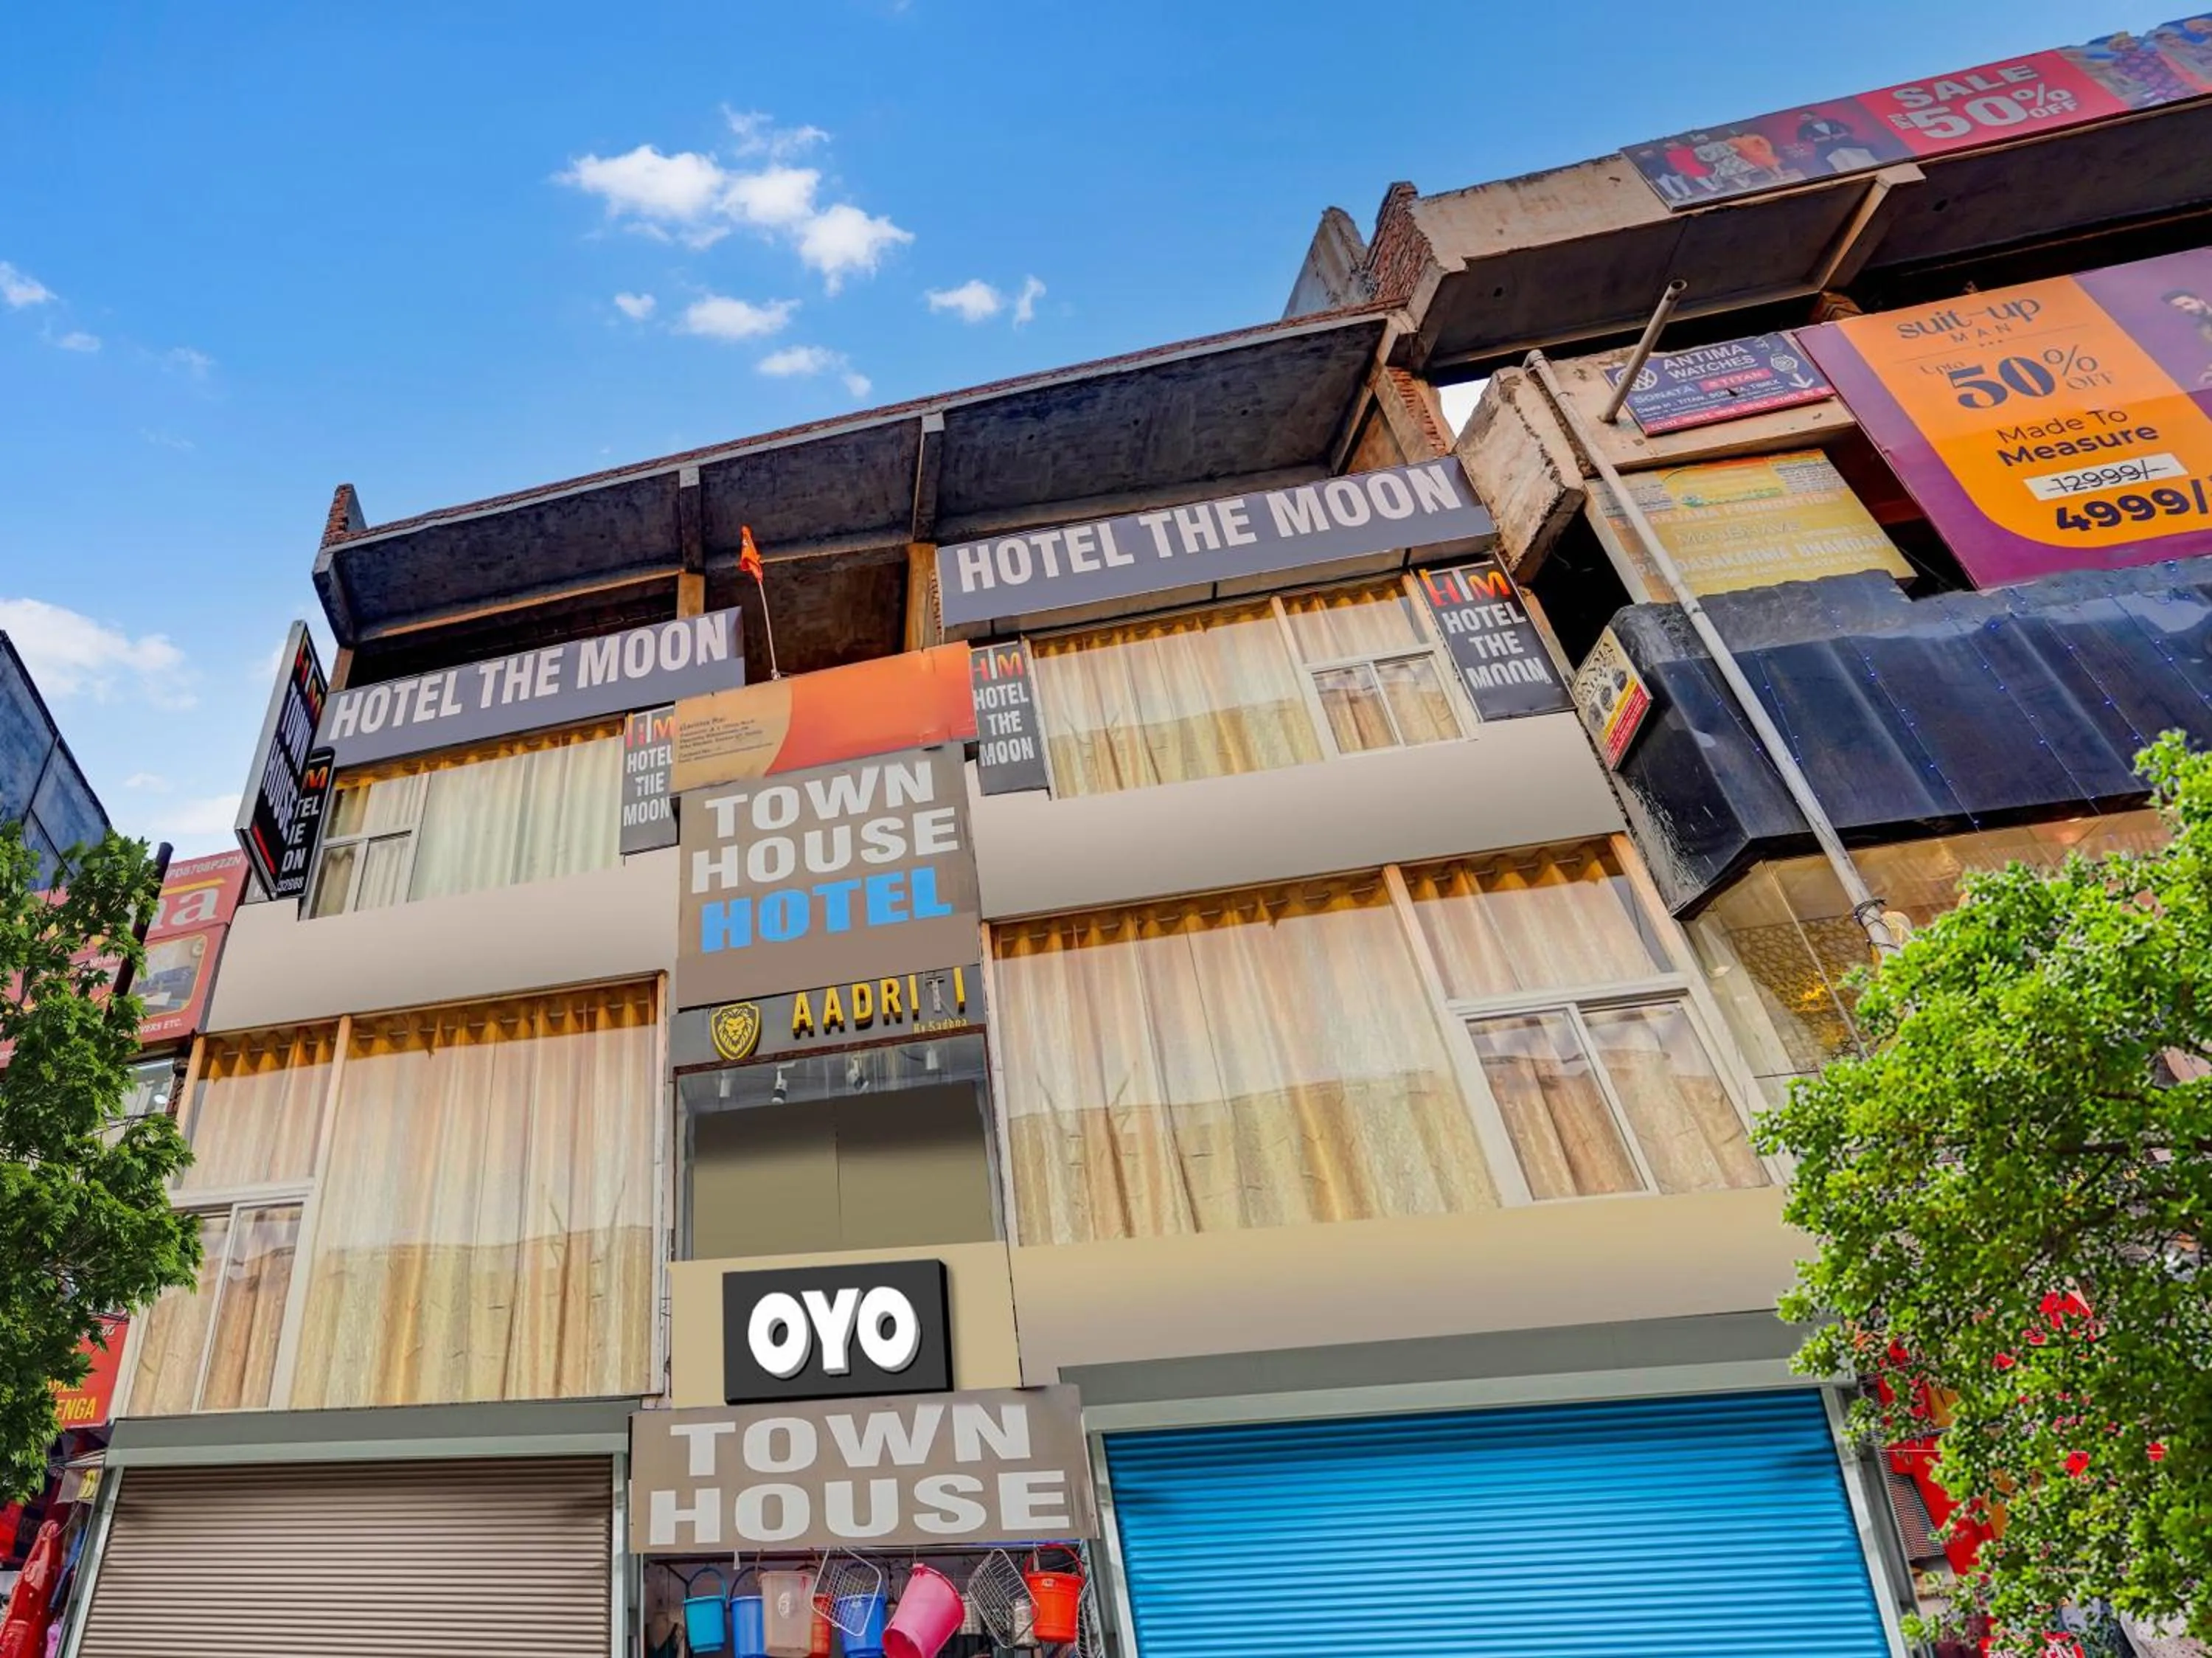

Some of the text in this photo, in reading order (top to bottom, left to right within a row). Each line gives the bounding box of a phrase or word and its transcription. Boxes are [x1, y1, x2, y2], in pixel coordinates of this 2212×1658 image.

[1892, 64, 2039, 108] SALE
[1907, 83, 2073, 139] 50%
[2029, 102, 2078, 118] OFF
[1896, 298, 2041, 339] suit-up
[1950, 322, 2011, 343] MAN
[1663, 344, 1750, 370] ANTIMA
[1667, 355, 1756, 380] WATCHES
[1718, 371, 1763, 388] TITAN
[1948, 344, 2099, 409] 50%
[2065, 371, 2114, 390] OFF
[1632, 384, 1696, 405] SONATA
[1997, 409, 2128, 444] Made To
[1997, 425, 2160, 467] Measure
[2056, 473, 2212, 532] 4999/
[957, 464, 1464, 592] HOTEL THE MOON
[1441, 601, 1527, 634] HOTEL
[1468, 631, 1524, 659] THE
[327, 612, 728, 740] HOTEL THE MOON
[973, 681, 1029, 711] HOTEL
[987, 710, 1023, 736] THE
[627, 743, 672, 774] HOTEL
[978, 736, 1035, 767] MOON
[634, 771, 665, 797] THE
[704, 760, 935, 839] TOWN
[623, 797, 670, 827] MOON
[691, 806, 959, 895] HOUSE
[700, 867, 953, 954] HOTEL
[792, 966, 966, 1036] AADRITI
[928, 1018, 967, 1033] Sadhna
[748, 1286, 920, 1379] OYO
[669, 1404, 1032, 1477] TOWN
[649, 1470, 1071, 1546] HOUSE
